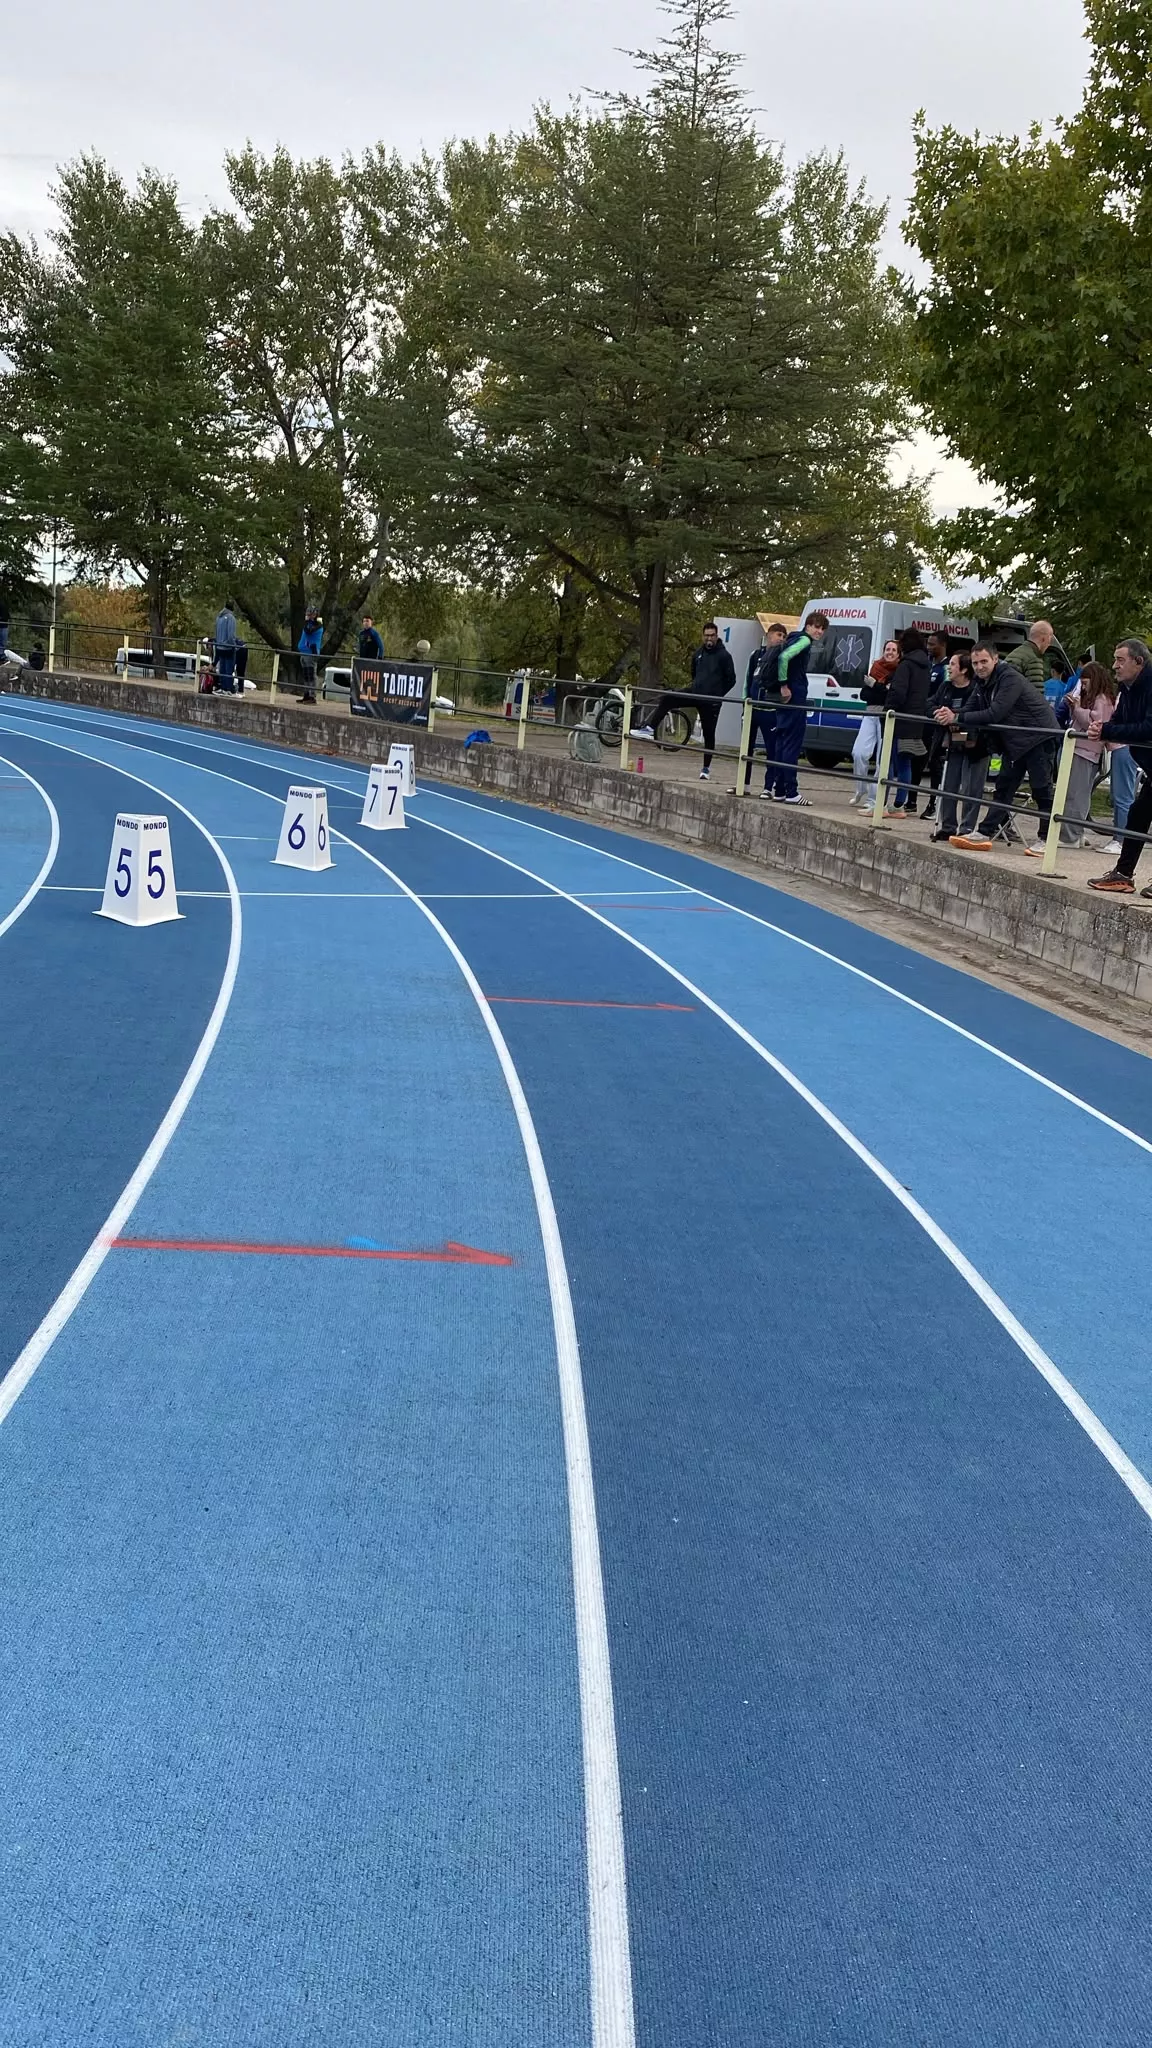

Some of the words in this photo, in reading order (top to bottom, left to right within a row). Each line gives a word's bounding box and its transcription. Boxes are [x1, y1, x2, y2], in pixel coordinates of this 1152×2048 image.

[813, 608, 867, 619] MBULANCIA
[723, 626, 731, 643] 1
[383, 672, 424, 698] TAMBO
[289, 790, 313, 799] MONDO
[369, 783, 379, 813] 7
[387, 786, 398, 815] 7
[116, 819, 139, 831] MONDO
[143, 821, 167, 831] MONDO
[287, 813, 306, 850] 6
[317, 813, 326, 851] 6
[114, 847, 132, 898] 5
[146, 849, 166, 899] 5
